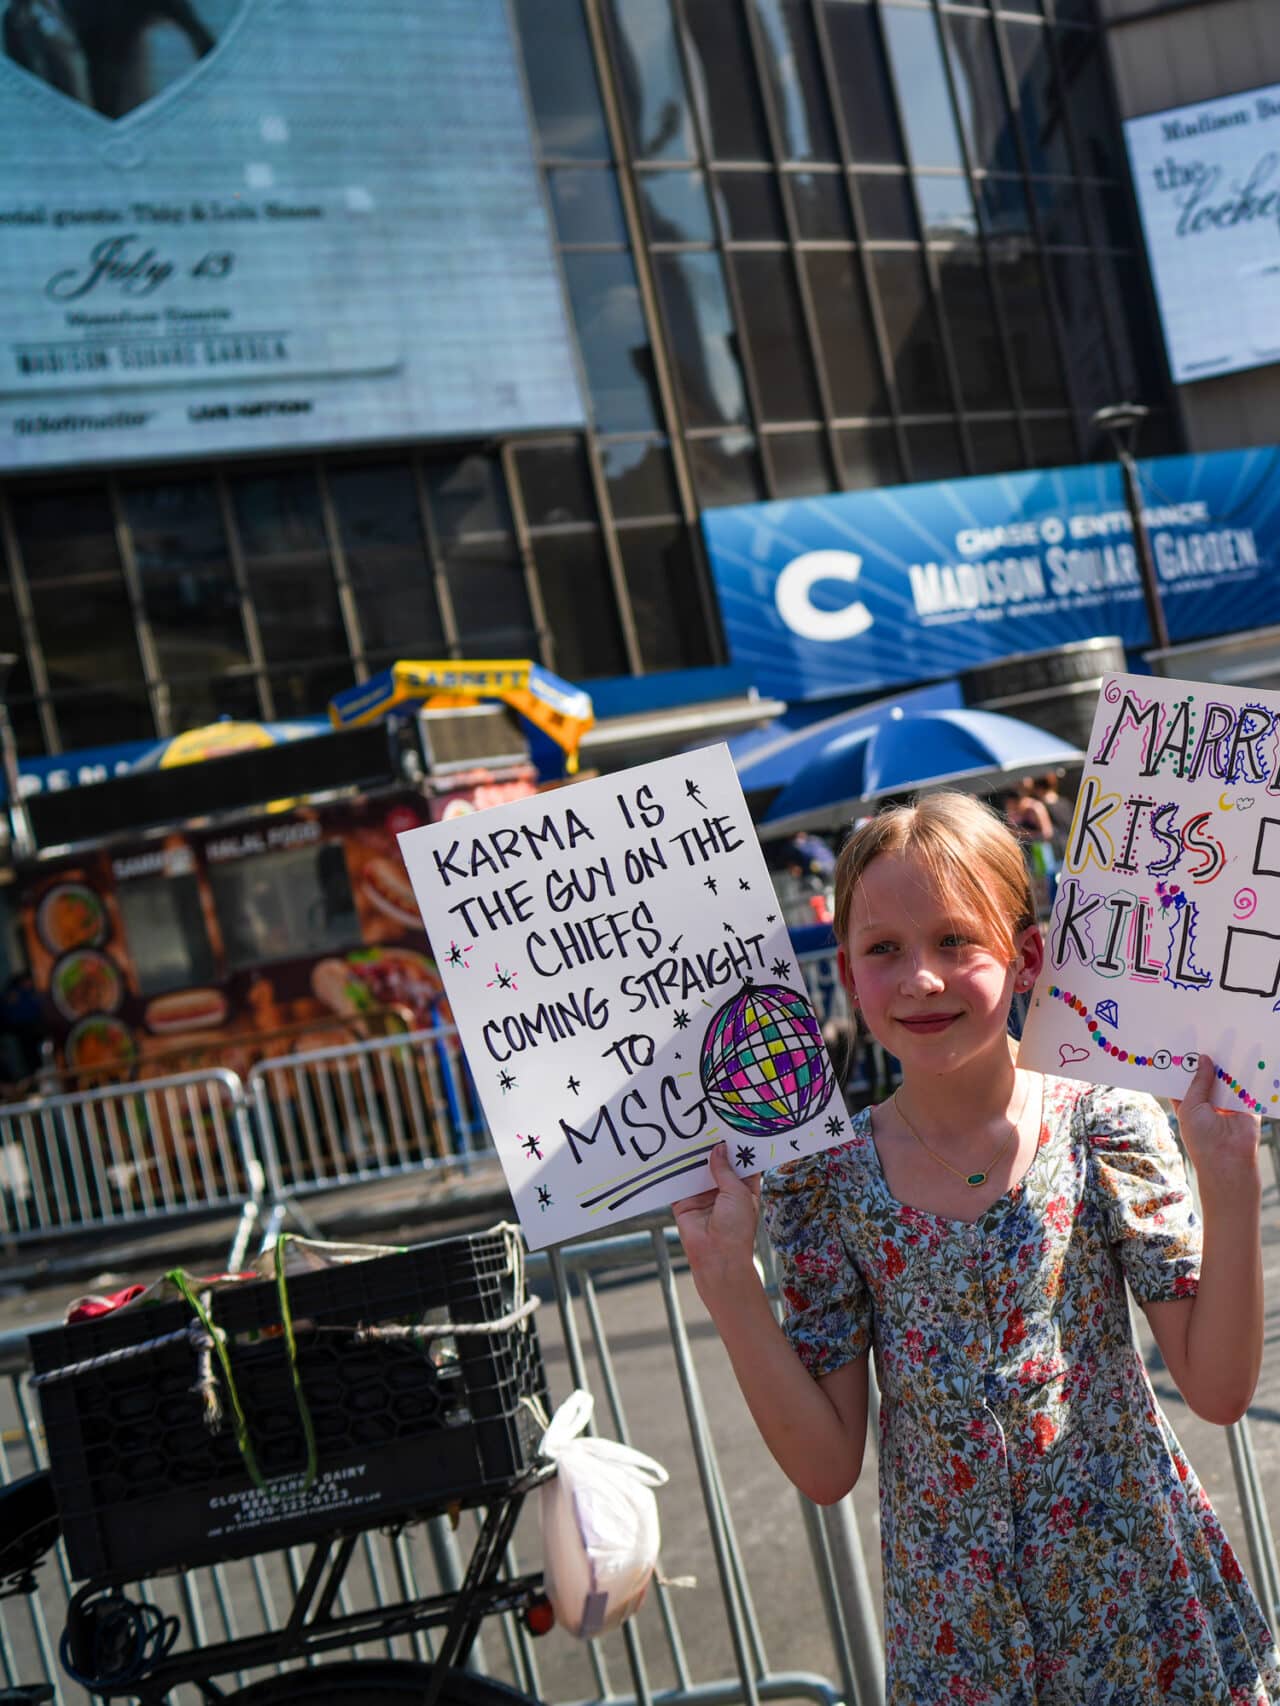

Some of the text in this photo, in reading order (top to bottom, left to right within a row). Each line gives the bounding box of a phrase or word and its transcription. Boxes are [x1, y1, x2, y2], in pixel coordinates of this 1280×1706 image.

[46, 232, 175, 303] July
[908, 554, 1046, 617] MADISON
[1045, 541, 1146, 597] SQUAR
[1153, 526, 1259, 582] GARDEN
[955, 500, 1208, 555] CHASE ENTANCE
[774, 549, 875, 643] C
[433, 783, 665, 888] KARMA IS
[1069, 777, 1225, 882] KISS
[448, 813, 746, 939] THE GUY ON THE
[526, 900, 664, 978] CHIEFS
[1054, 880, 1212, 986] KILL
[481, 932, 768, 1063] COMING STRAIGHT
[600, 1032, 656, 1076] TO
[558, 1074, 709, 1166] MSG
[208, 1486, 267, 1510] CLOVER
[322, 1463, 368, 1483] DAIRY
